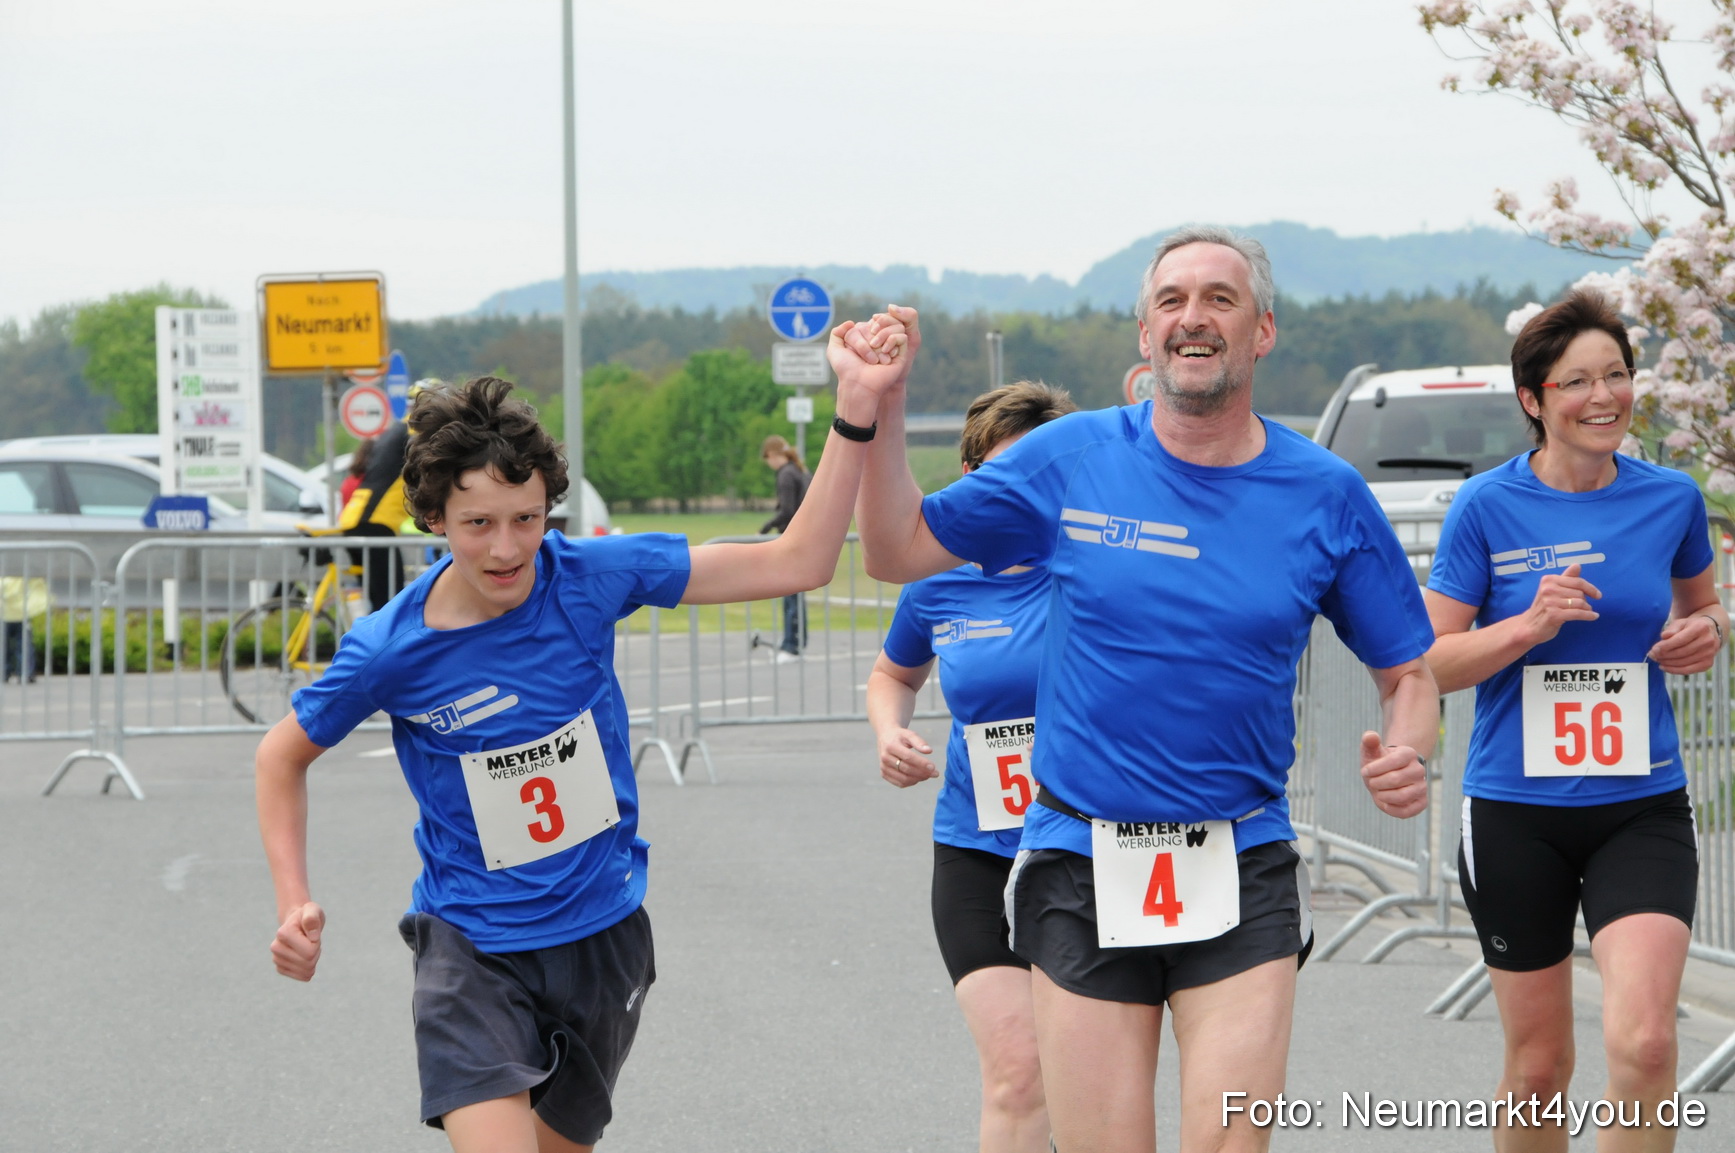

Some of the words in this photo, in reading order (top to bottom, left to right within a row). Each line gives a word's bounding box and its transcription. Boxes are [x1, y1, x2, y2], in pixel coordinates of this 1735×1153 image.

[276, 312, 371, 335] Neumarkt
[155, 510, 205, 530] VOLVO
[1544, 669, 1600, 682] MEYER
[1544, 682, 1601, 692] WERBUNG
[985, 723, 1035, 740] MEYER
[1554, 701, 1623, 766] 56
[487, 742, 553, 770] MEYER
[489, 756, 555, 780] WERBUNG
[996, 754, 1040, 816] 5
[519, 776, 565, 843] 3
[1116, 822, 1181, 838] MEYER
[1117, 835, 1182, 849] WERBUNG
[1142, 852, 1184, 927] 4
